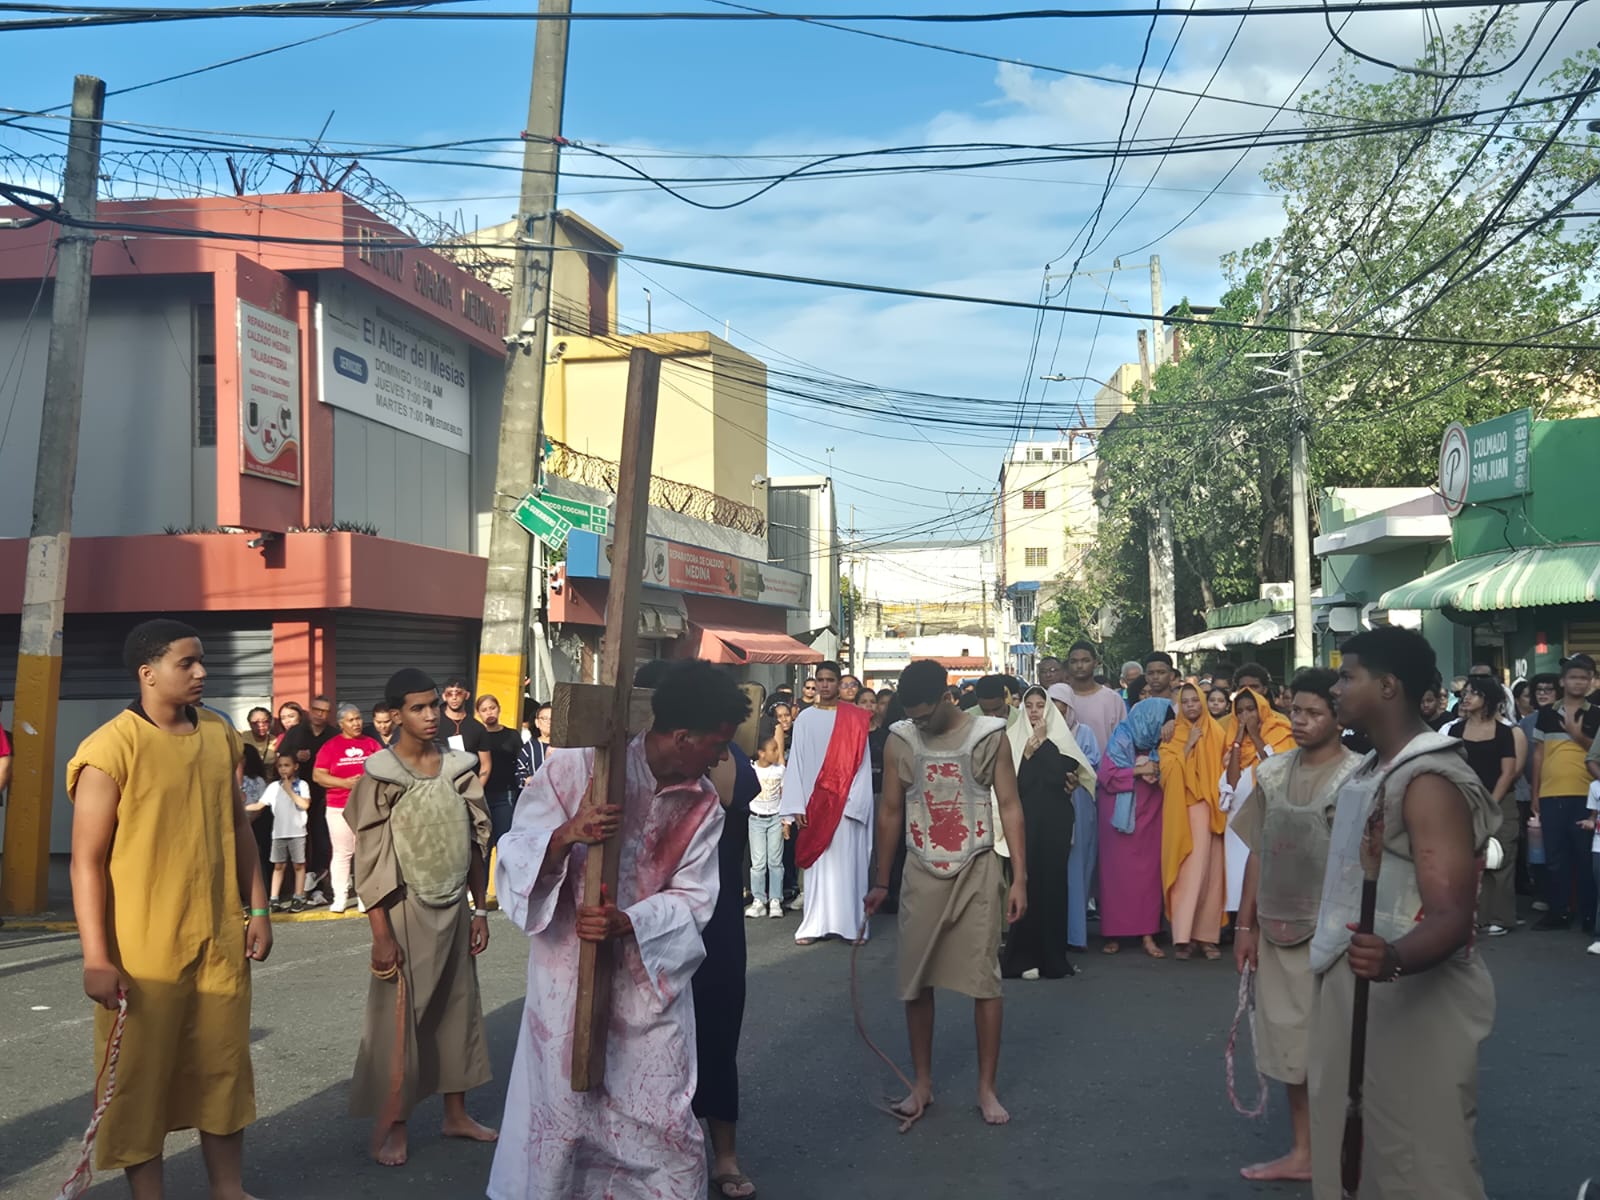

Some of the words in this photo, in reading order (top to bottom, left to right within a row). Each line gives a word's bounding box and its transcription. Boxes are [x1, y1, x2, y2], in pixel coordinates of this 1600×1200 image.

[247, 315, 281, 337] REPARADORA
[282, 329, 290, 339] DE
[363, 317, 375, 345] El
[379, 325, 407, 360] Altar
[411, 344, 427, 369] del
[375, 358, 412, 384] DOMINGO
[414, 371, 431, 392] 10:00
[432, 381, 443, 398] AM
[374, 375, 405, 399] JUEVES
[407, 388, 421, 405] 7:00
[422, 395, 433, 410] PM
[376, 395, 408, 417] MARTES
[409, 406, 424, 423] 7:00
[425, 412, 435, 428] PM
[1474, 431, 1508, 458] COLMADO
[1472, 462, 1488, 484] SAN
[1488, 456, 1509, 481] JUAN
[670, 548, 699, 563] REPARADORA
[699, 556, 705, 564] DE
[706, 557, 724, 569] CALZADO
[685, 565, 710, 581] MEDINA
[1515, 658, 1528, 677] NO
